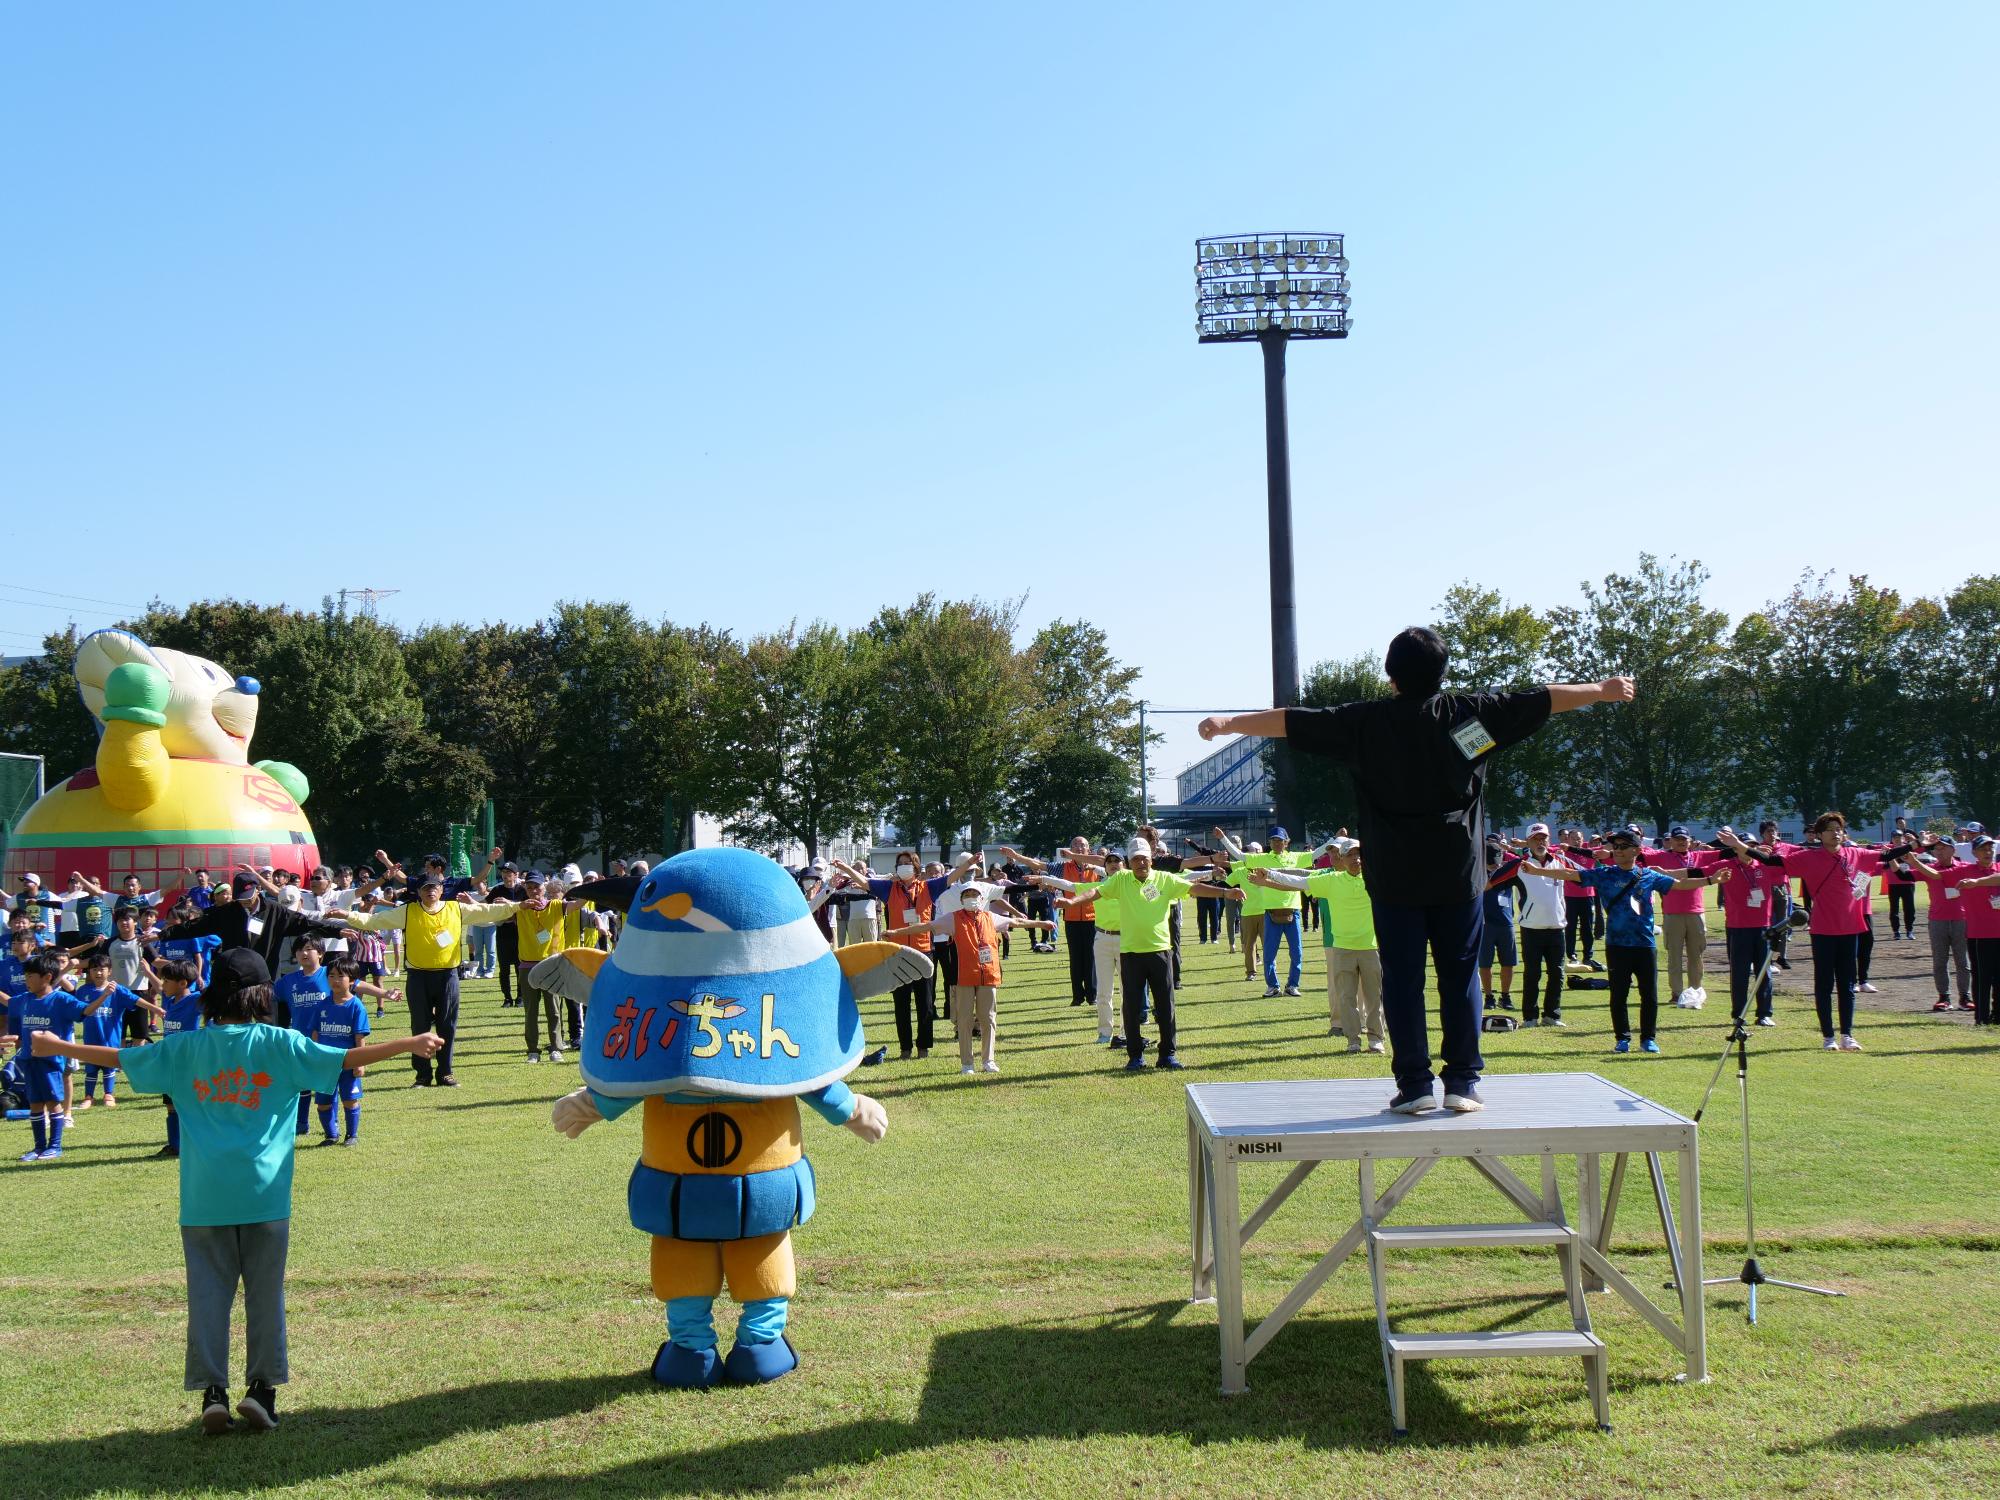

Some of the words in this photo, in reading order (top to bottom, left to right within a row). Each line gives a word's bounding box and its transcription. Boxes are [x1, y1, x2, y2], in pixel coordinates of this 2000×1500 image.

[292, 991, 326, 1003] Harimao
[163, 1020, 182, 1030] imao
[320, 1022, 352, 1034] Harimao
[603, 993, 800, 1060] あいちゃん
[1238, 1142, 1282, 1154] NISHI
